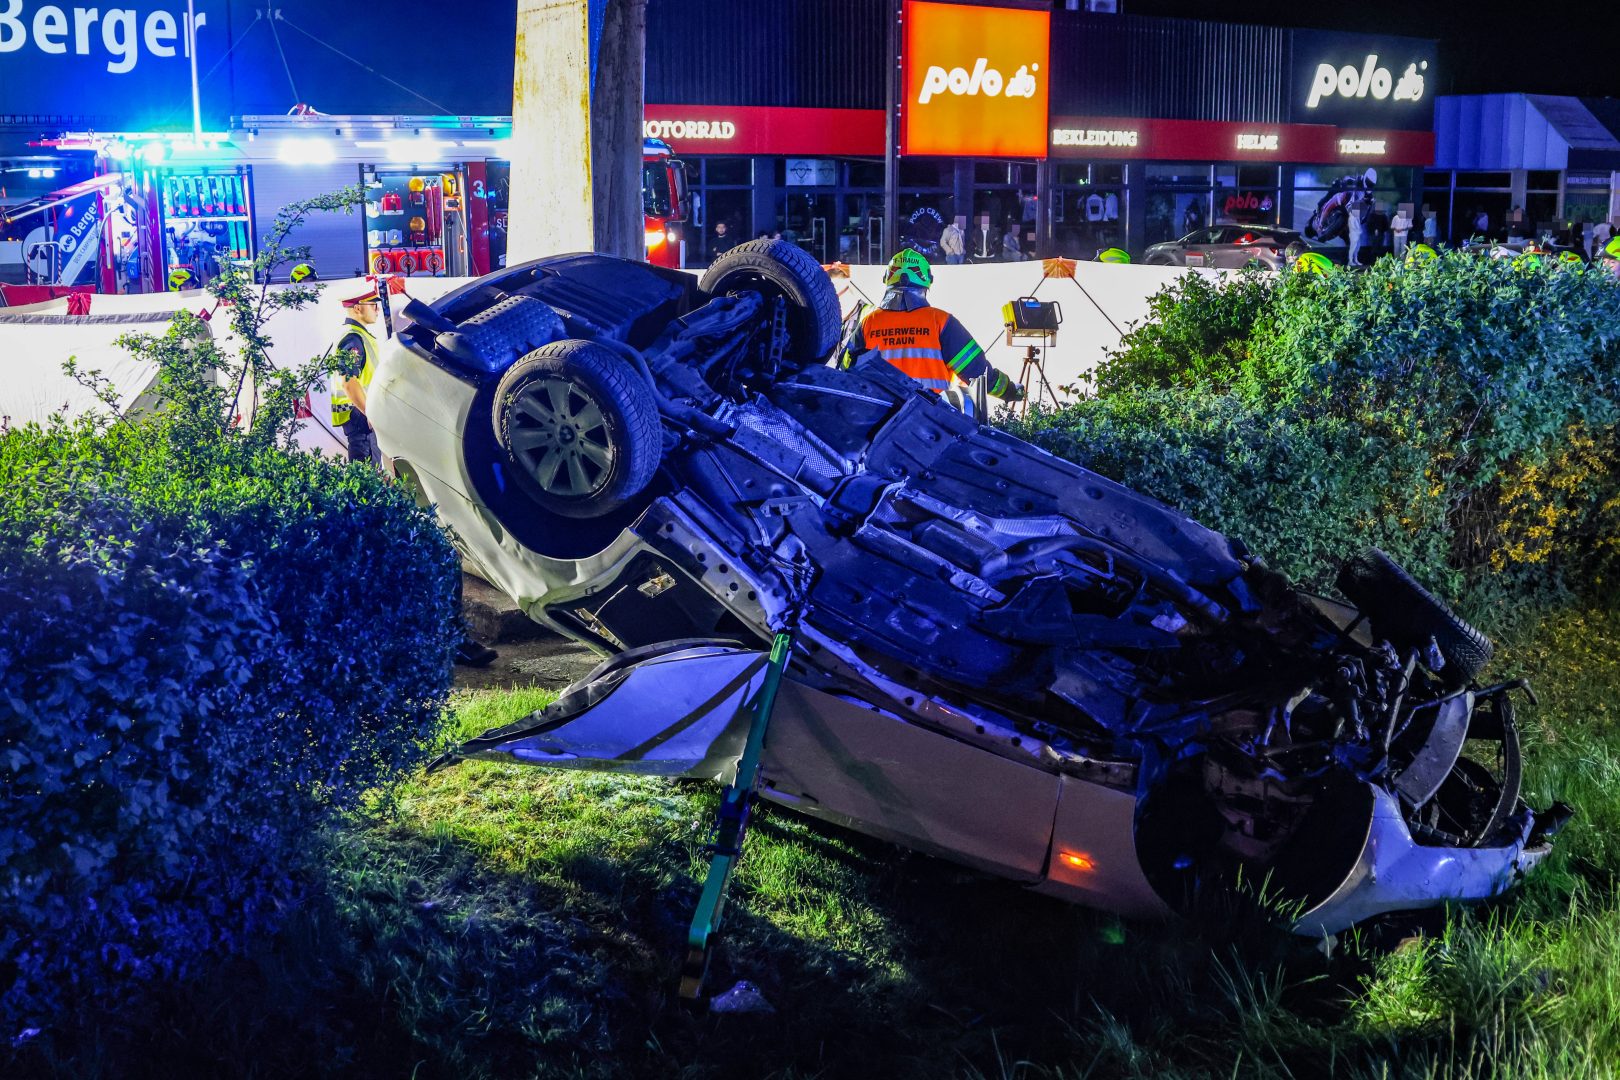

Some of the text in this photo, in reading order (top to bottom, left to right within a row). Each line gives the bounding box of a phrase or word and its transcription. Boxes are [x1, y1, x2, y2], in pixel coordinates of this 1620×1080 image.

[0, 0, 206, 74] Berger
[918, 57, 1003, 104] polo
[1305, 54, 1393, 108] polo
[1052, 128, 1138, 147] BEKLEIDUNG
[1223, 191, 1259, 216] polo
[909, 207, 943, 224] POLO CREW
[870, 327, 930, 338] FEUERWEHR
[883, 337, 915, 346] TRAUN
